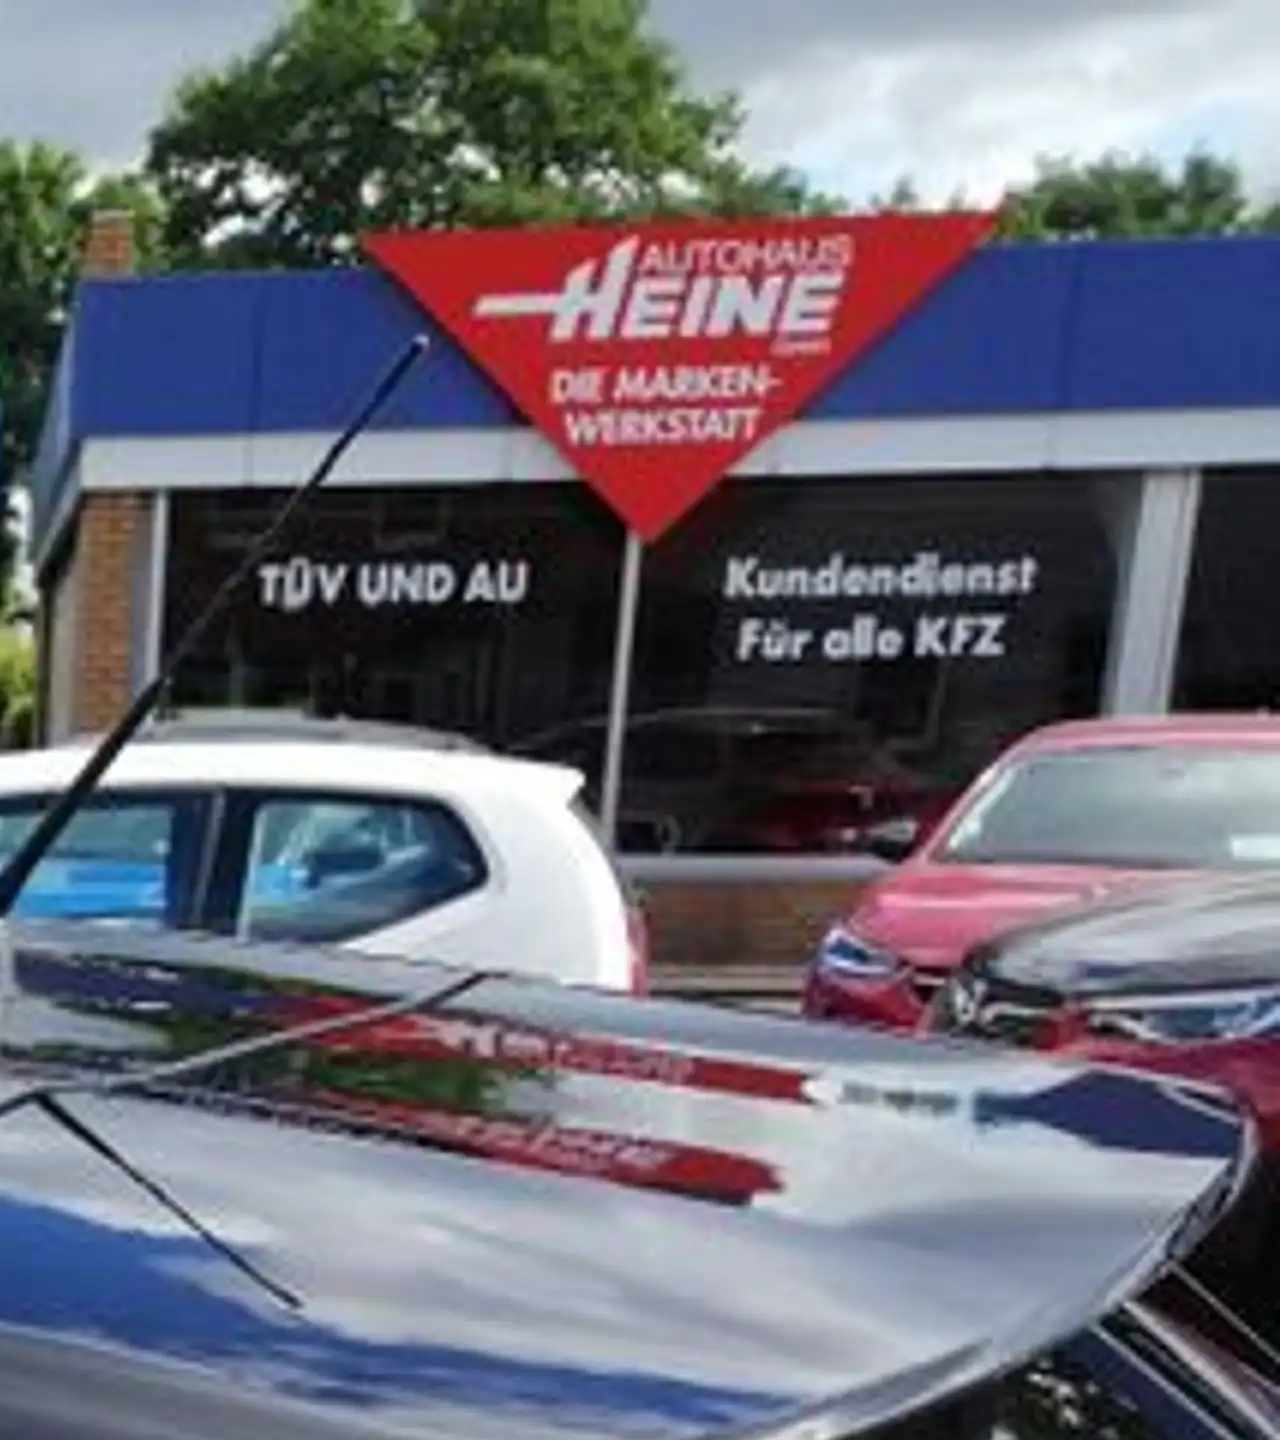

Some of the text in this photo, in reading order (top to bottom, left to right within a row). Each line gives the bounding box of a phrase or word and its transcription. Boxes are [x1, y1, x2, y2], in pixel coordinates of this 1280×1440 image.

[639, 235, 854, 273] AUTOHAUS
[474, 236, 844, 342] HEINE
[550, 362, 784, 402] DIE MARKEN-
[563, 407, 766, 447] WERKSTATT
[258, 557, 527, 613] TÜV UND AU
[724, 553, 1037, 598] Kundendienst
[737, 613, 1008, 661] Für alle KFZ
